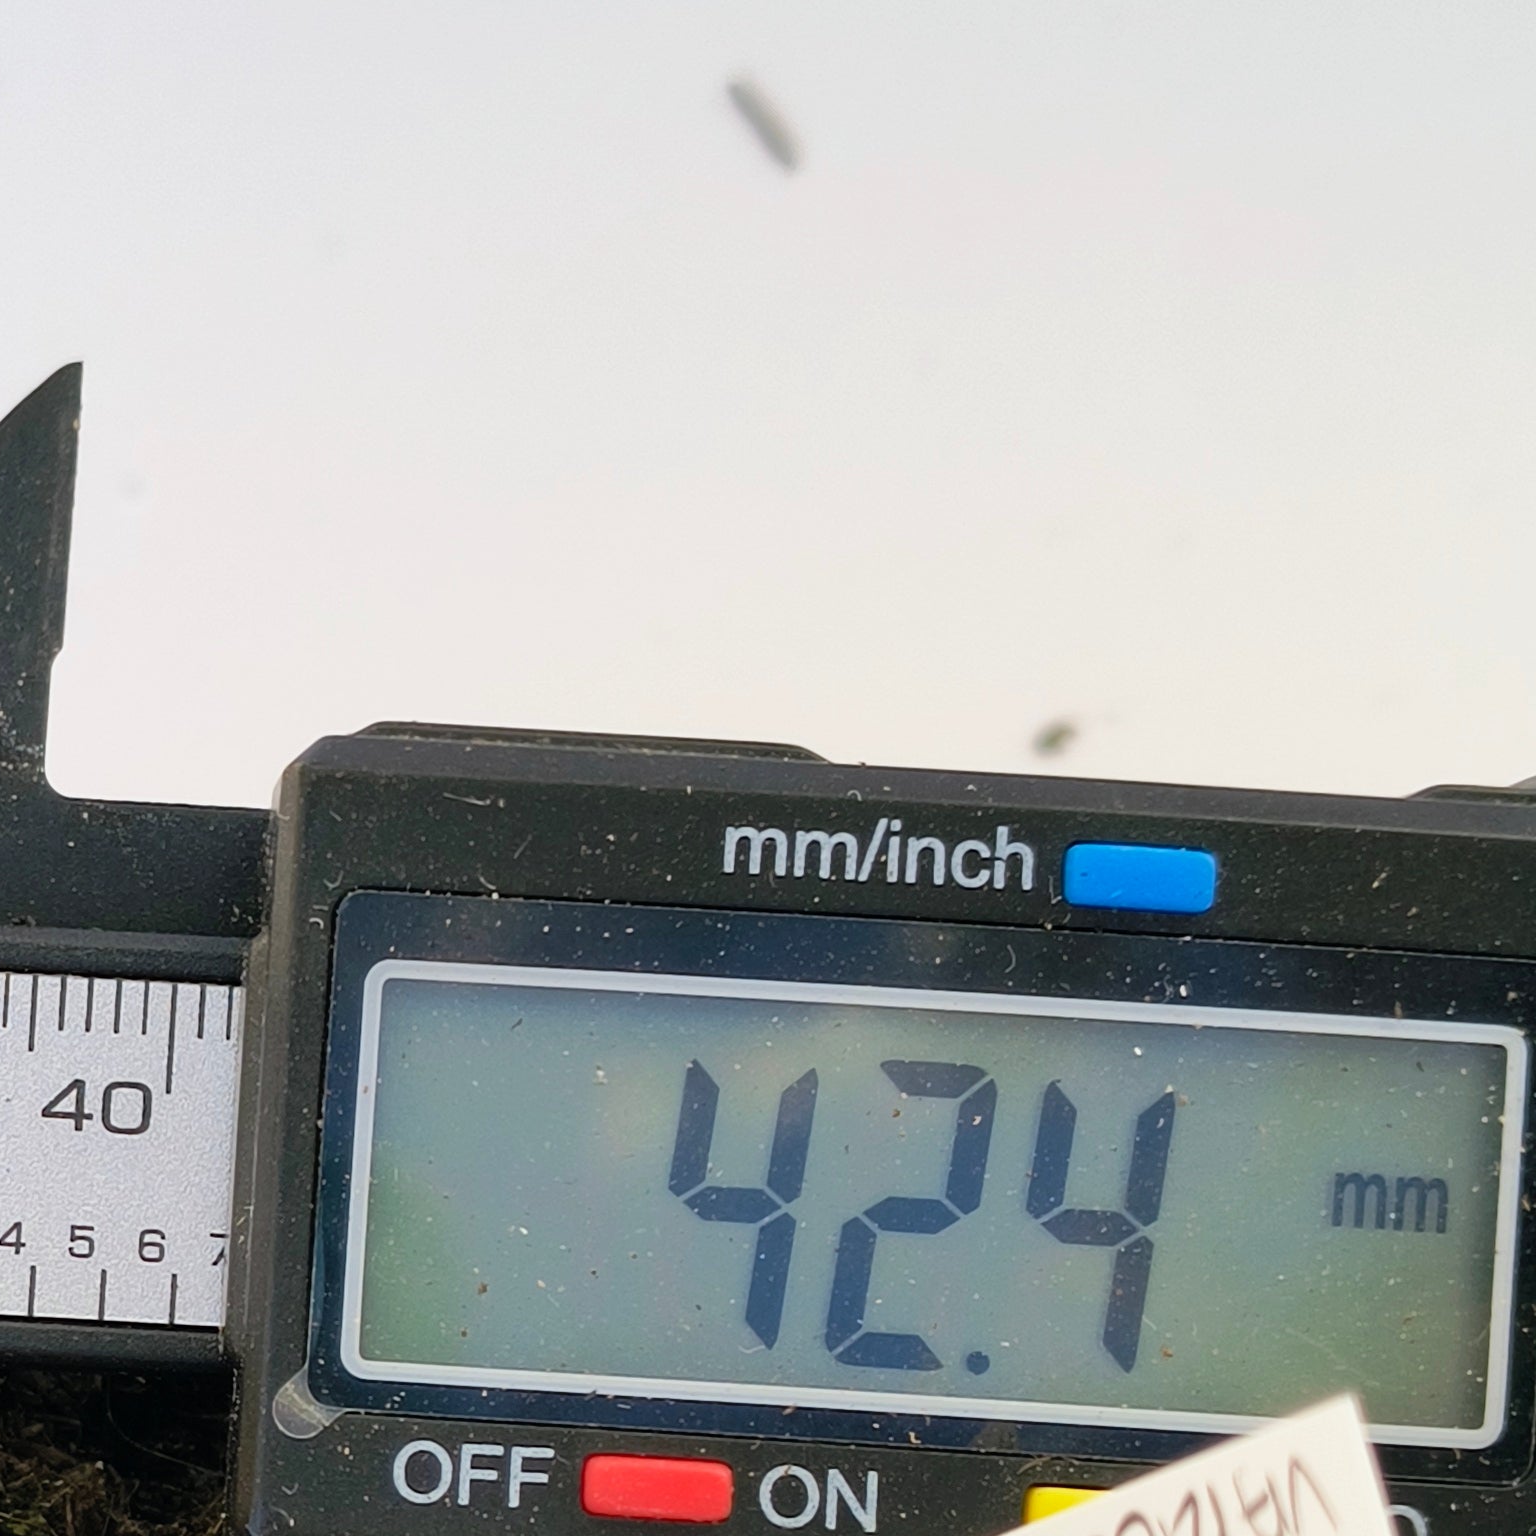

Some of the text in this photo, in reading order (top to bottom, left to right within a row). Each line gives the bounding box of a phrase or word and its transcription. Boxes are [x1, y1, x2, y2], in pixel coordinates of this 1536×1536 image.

[721, 816, 1037, 892] mm/inch
[41, 1079, 153, 1136] 40
[67, 1225, 95, 1259] 5
[137, 1229, 166, 1263] 6
[668, 1058, 1451, 1377] 42.4 mm
[392, 1439, 556, 1509] OFF
[758, 1464, 880, 1534] ON
